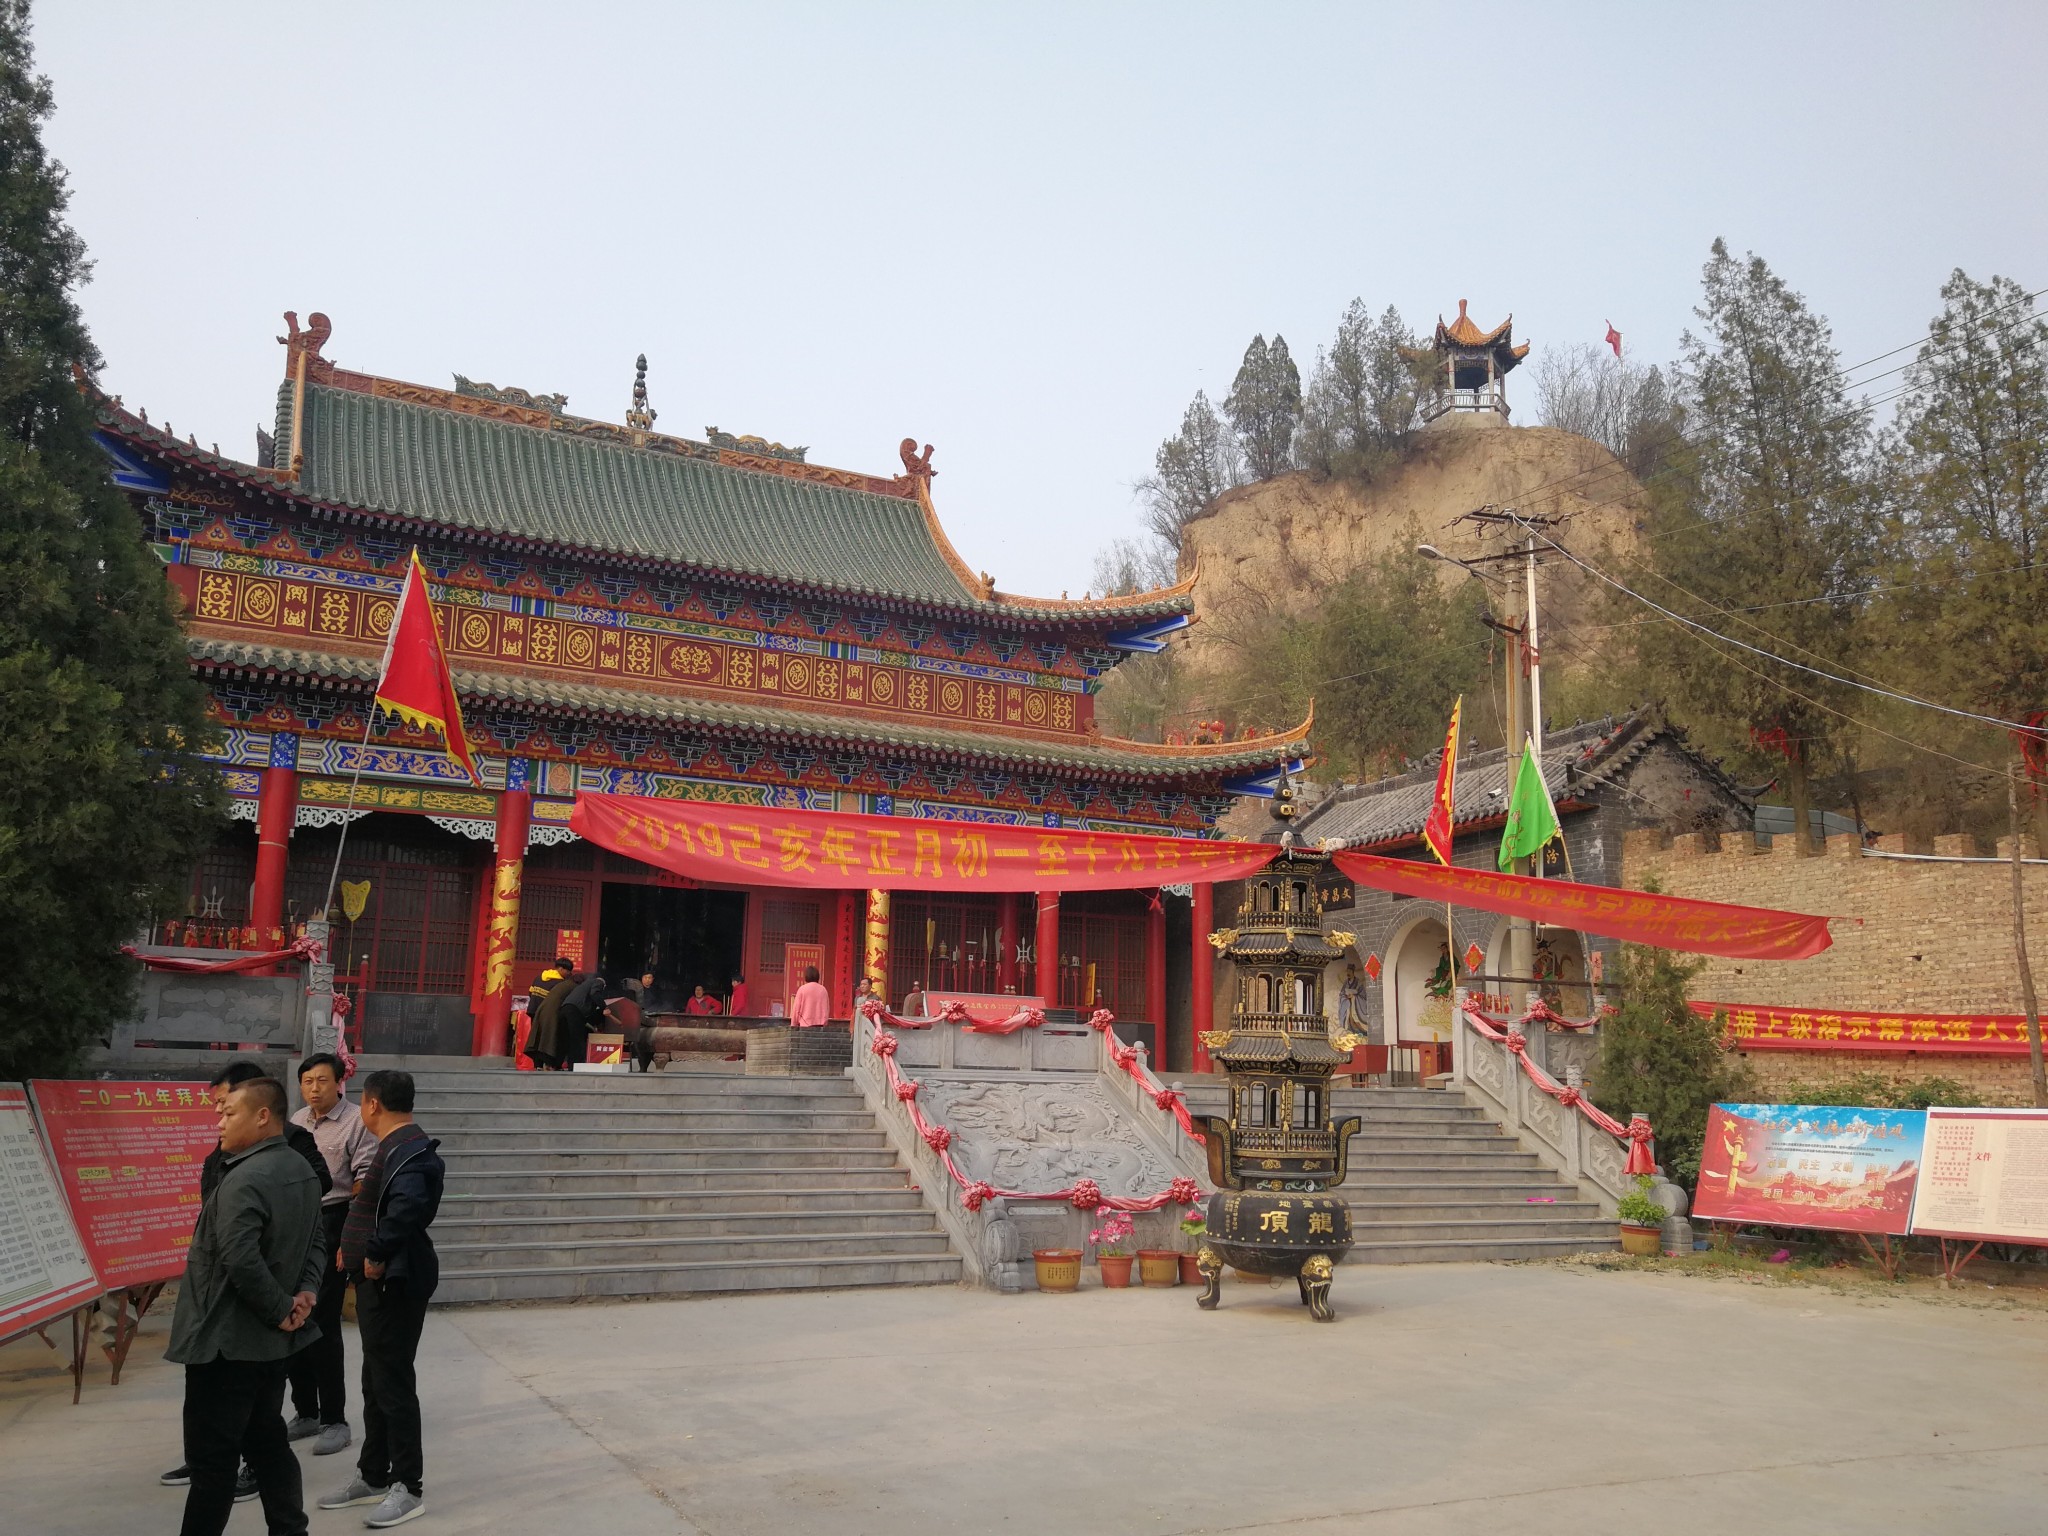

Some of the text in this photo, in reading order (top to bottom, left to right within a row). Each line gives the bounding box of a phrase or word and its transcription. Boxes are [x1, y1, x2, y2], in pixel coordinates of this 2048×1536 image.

[1974, 1151, 1992, 1161] 文件
[1798, 1158, 1821, 1170] 民主
[1762, 1188, 1784, 1199] 爱国
